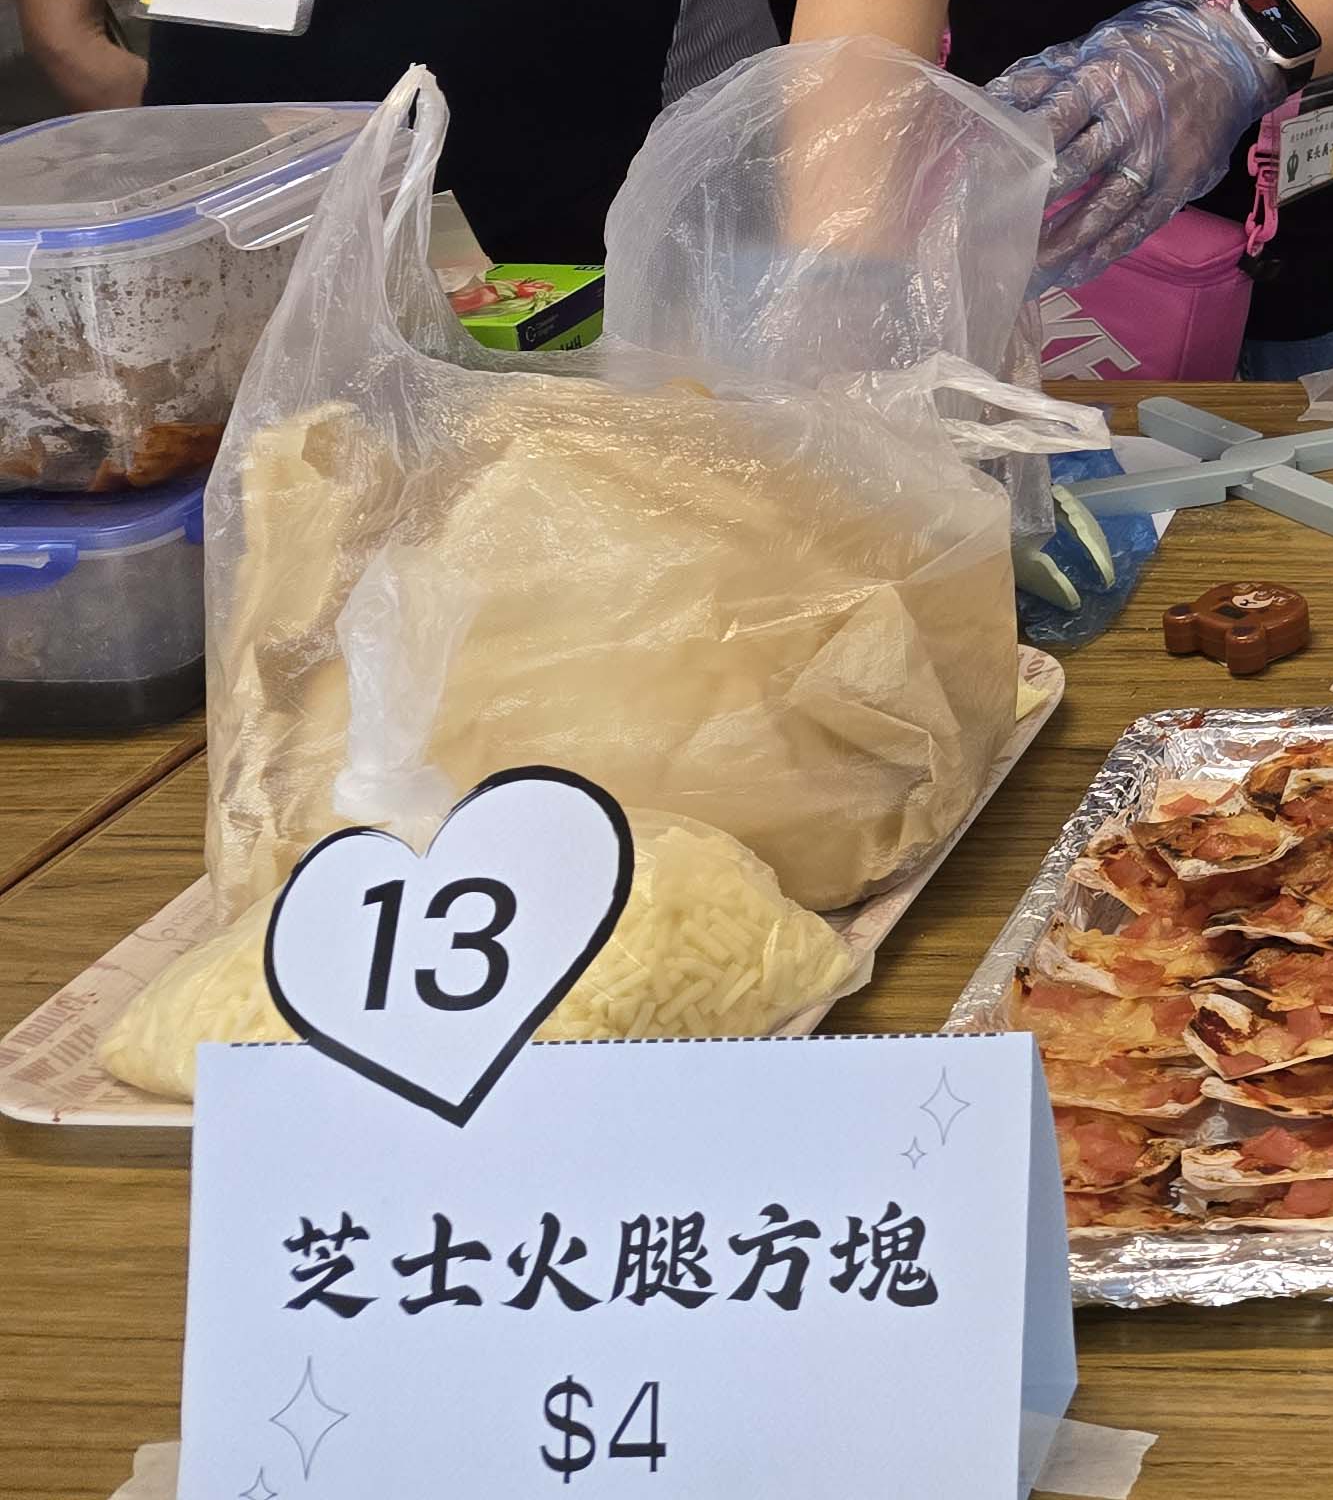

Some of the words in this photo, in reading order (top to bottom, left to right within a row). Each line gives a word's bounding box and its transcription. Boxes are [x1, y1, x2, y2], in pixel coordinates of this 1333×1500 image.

[361, 877, 518, 1013] 13
[282, 1201, 940, 1320] 芝士火腿方塊
[540, 1375, 667, 1484] $4
